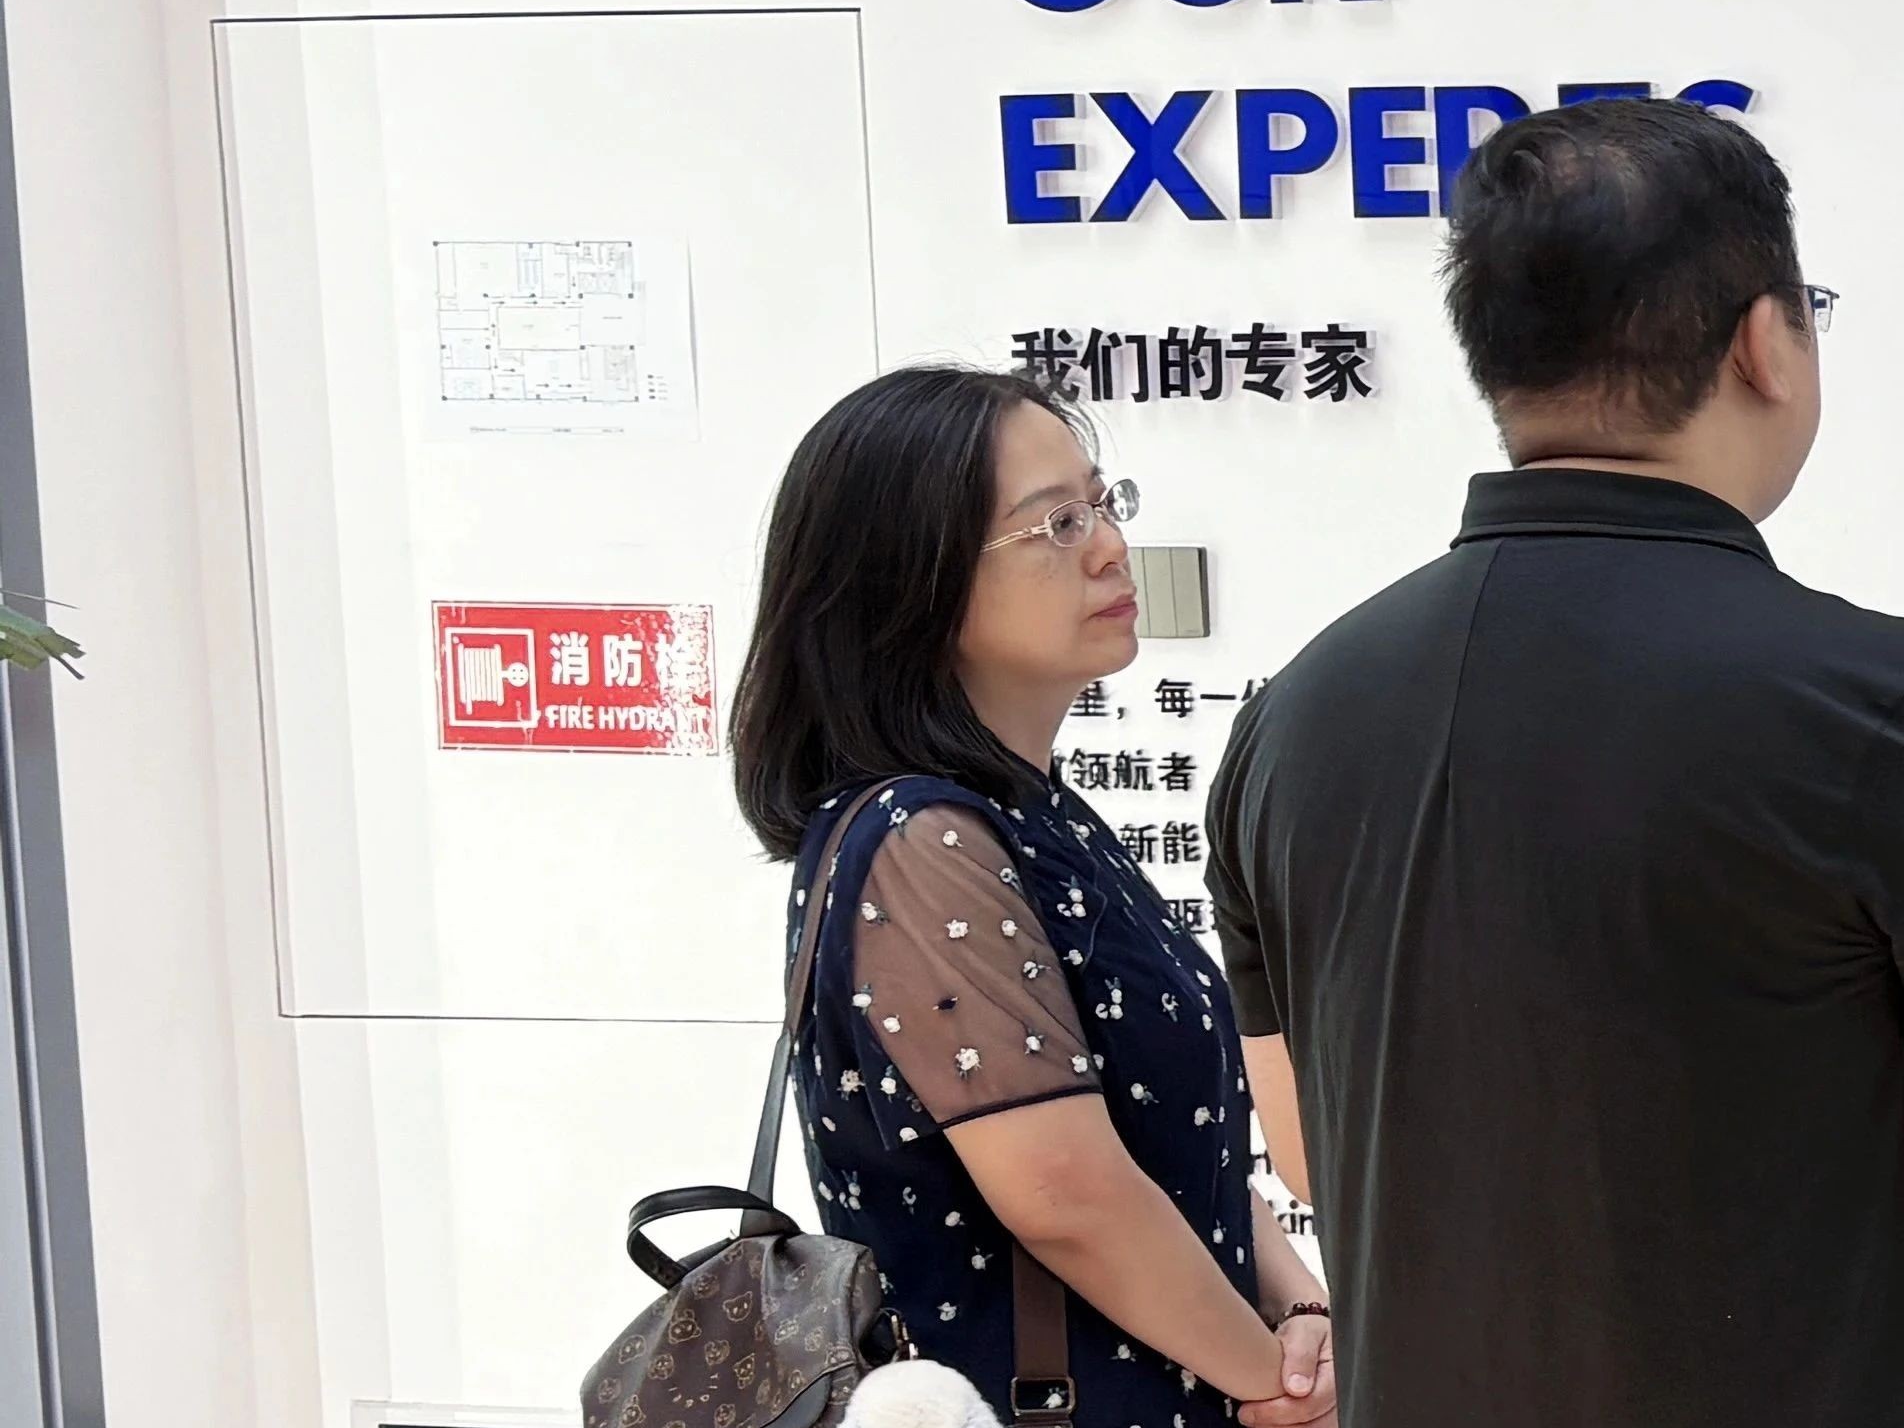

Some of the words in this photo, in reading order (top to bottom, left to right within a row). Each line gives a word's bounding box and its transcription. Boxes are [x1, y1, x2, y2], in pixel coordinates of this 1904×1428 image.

[999, 80, 1761, 224] EXPER
[1011, 323, 1376, 403] 我们的专家
[548, 705, 594, 730] FIRE
[599, 705, 709, 732] HYDRANT
[1062, 748, 1197, 792] 领航者
